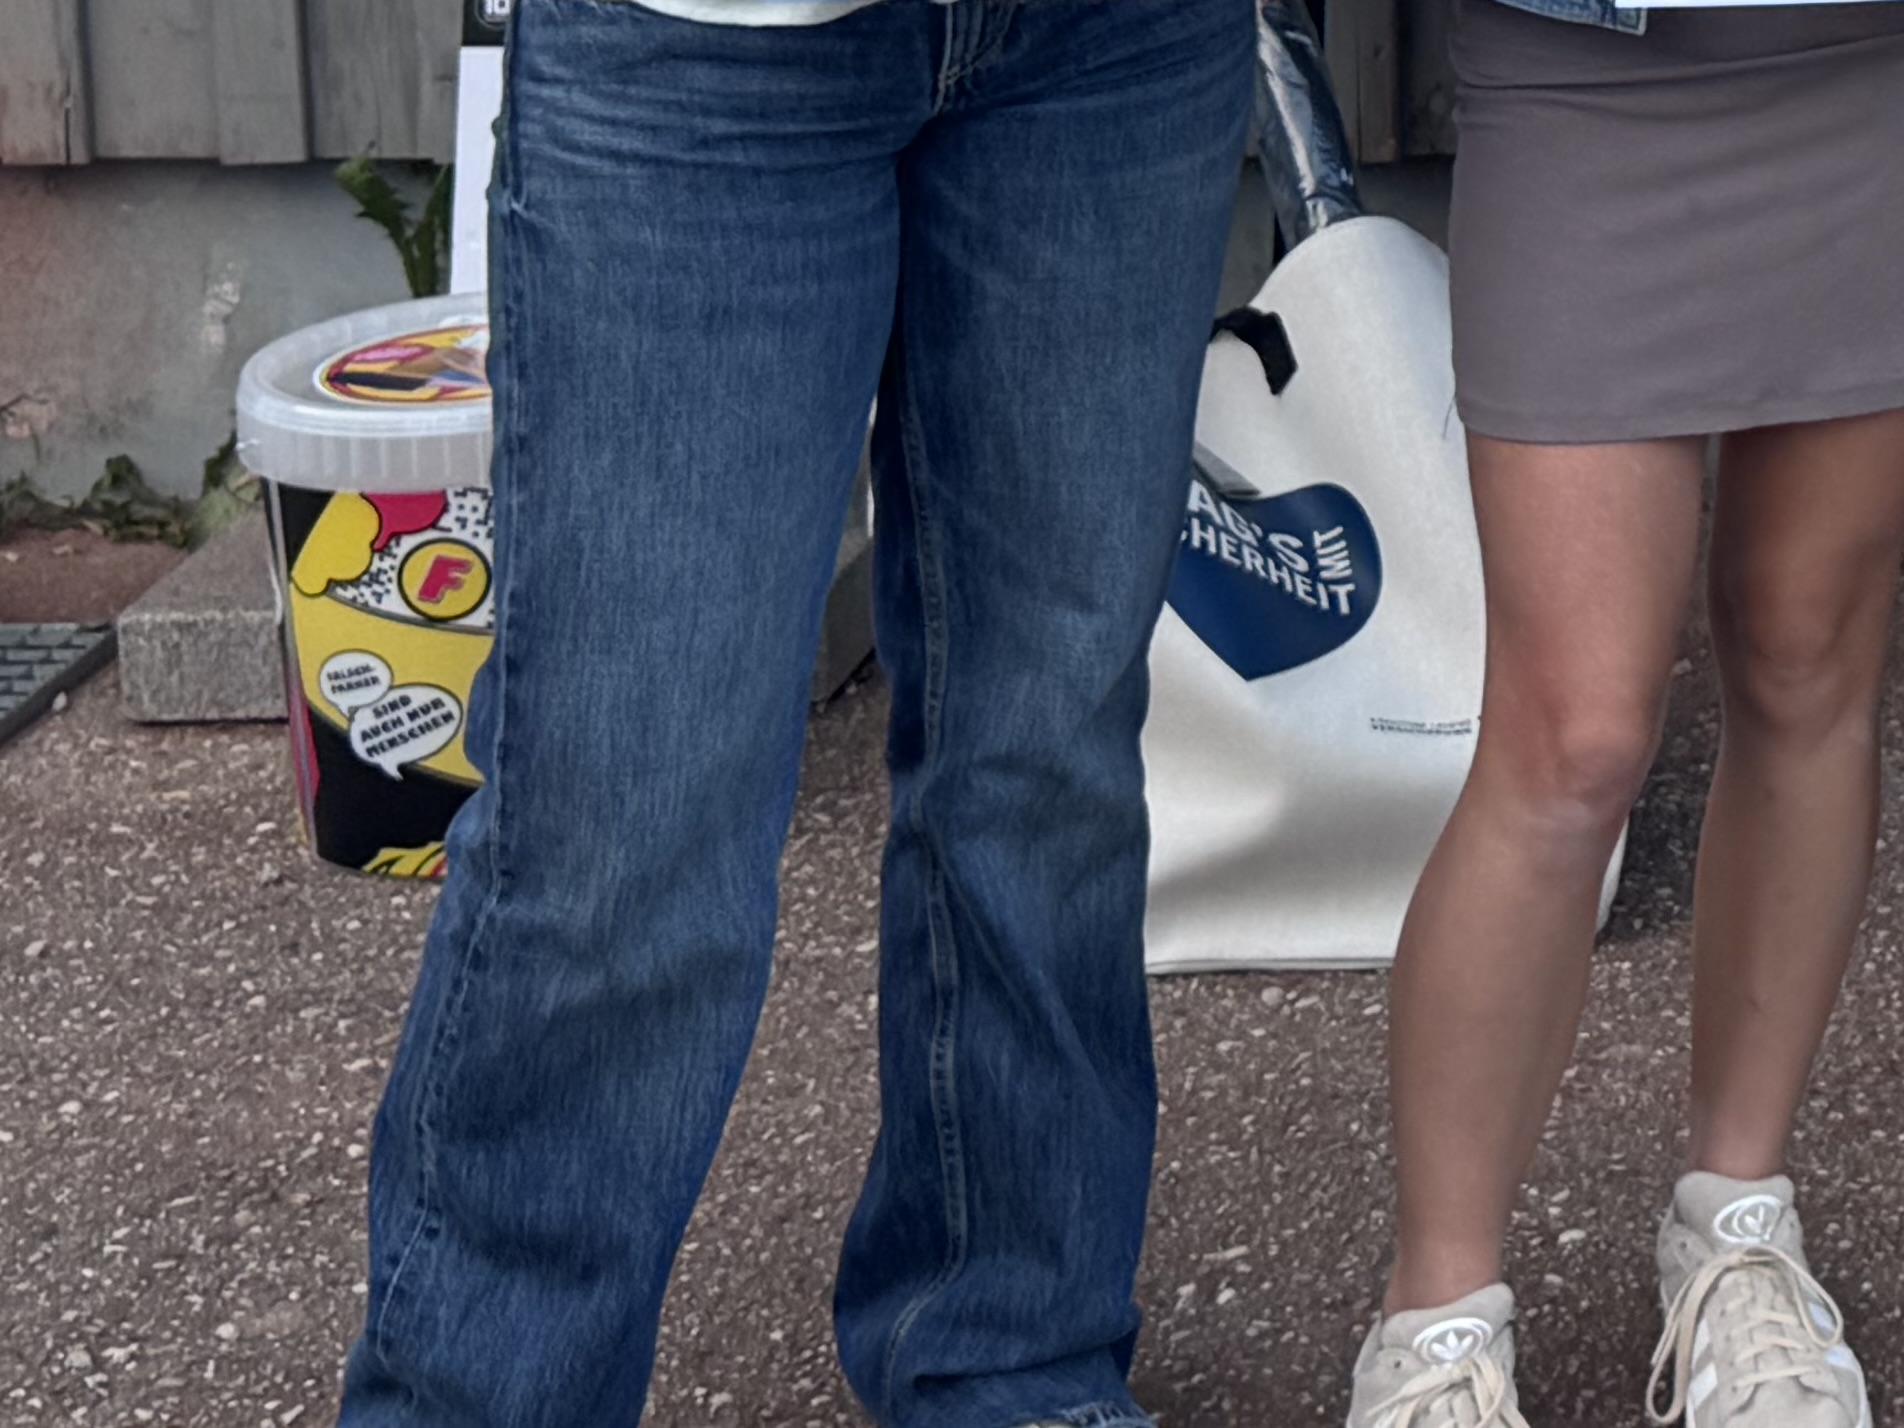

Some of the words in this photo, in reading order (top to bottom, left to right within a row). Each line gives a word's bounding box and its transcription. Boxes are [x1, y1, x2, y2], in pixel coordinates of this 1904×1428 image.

[1180, 516, 1356, 616] HERHEIT
[1312, 525, 1354, 580] MIT
[417, 554, 473, 604] F
[359, 715, 405, 744] AUCH
[371, 694, 413, 720] SIND
[364, 709, 456, 758] MENSCHEN
